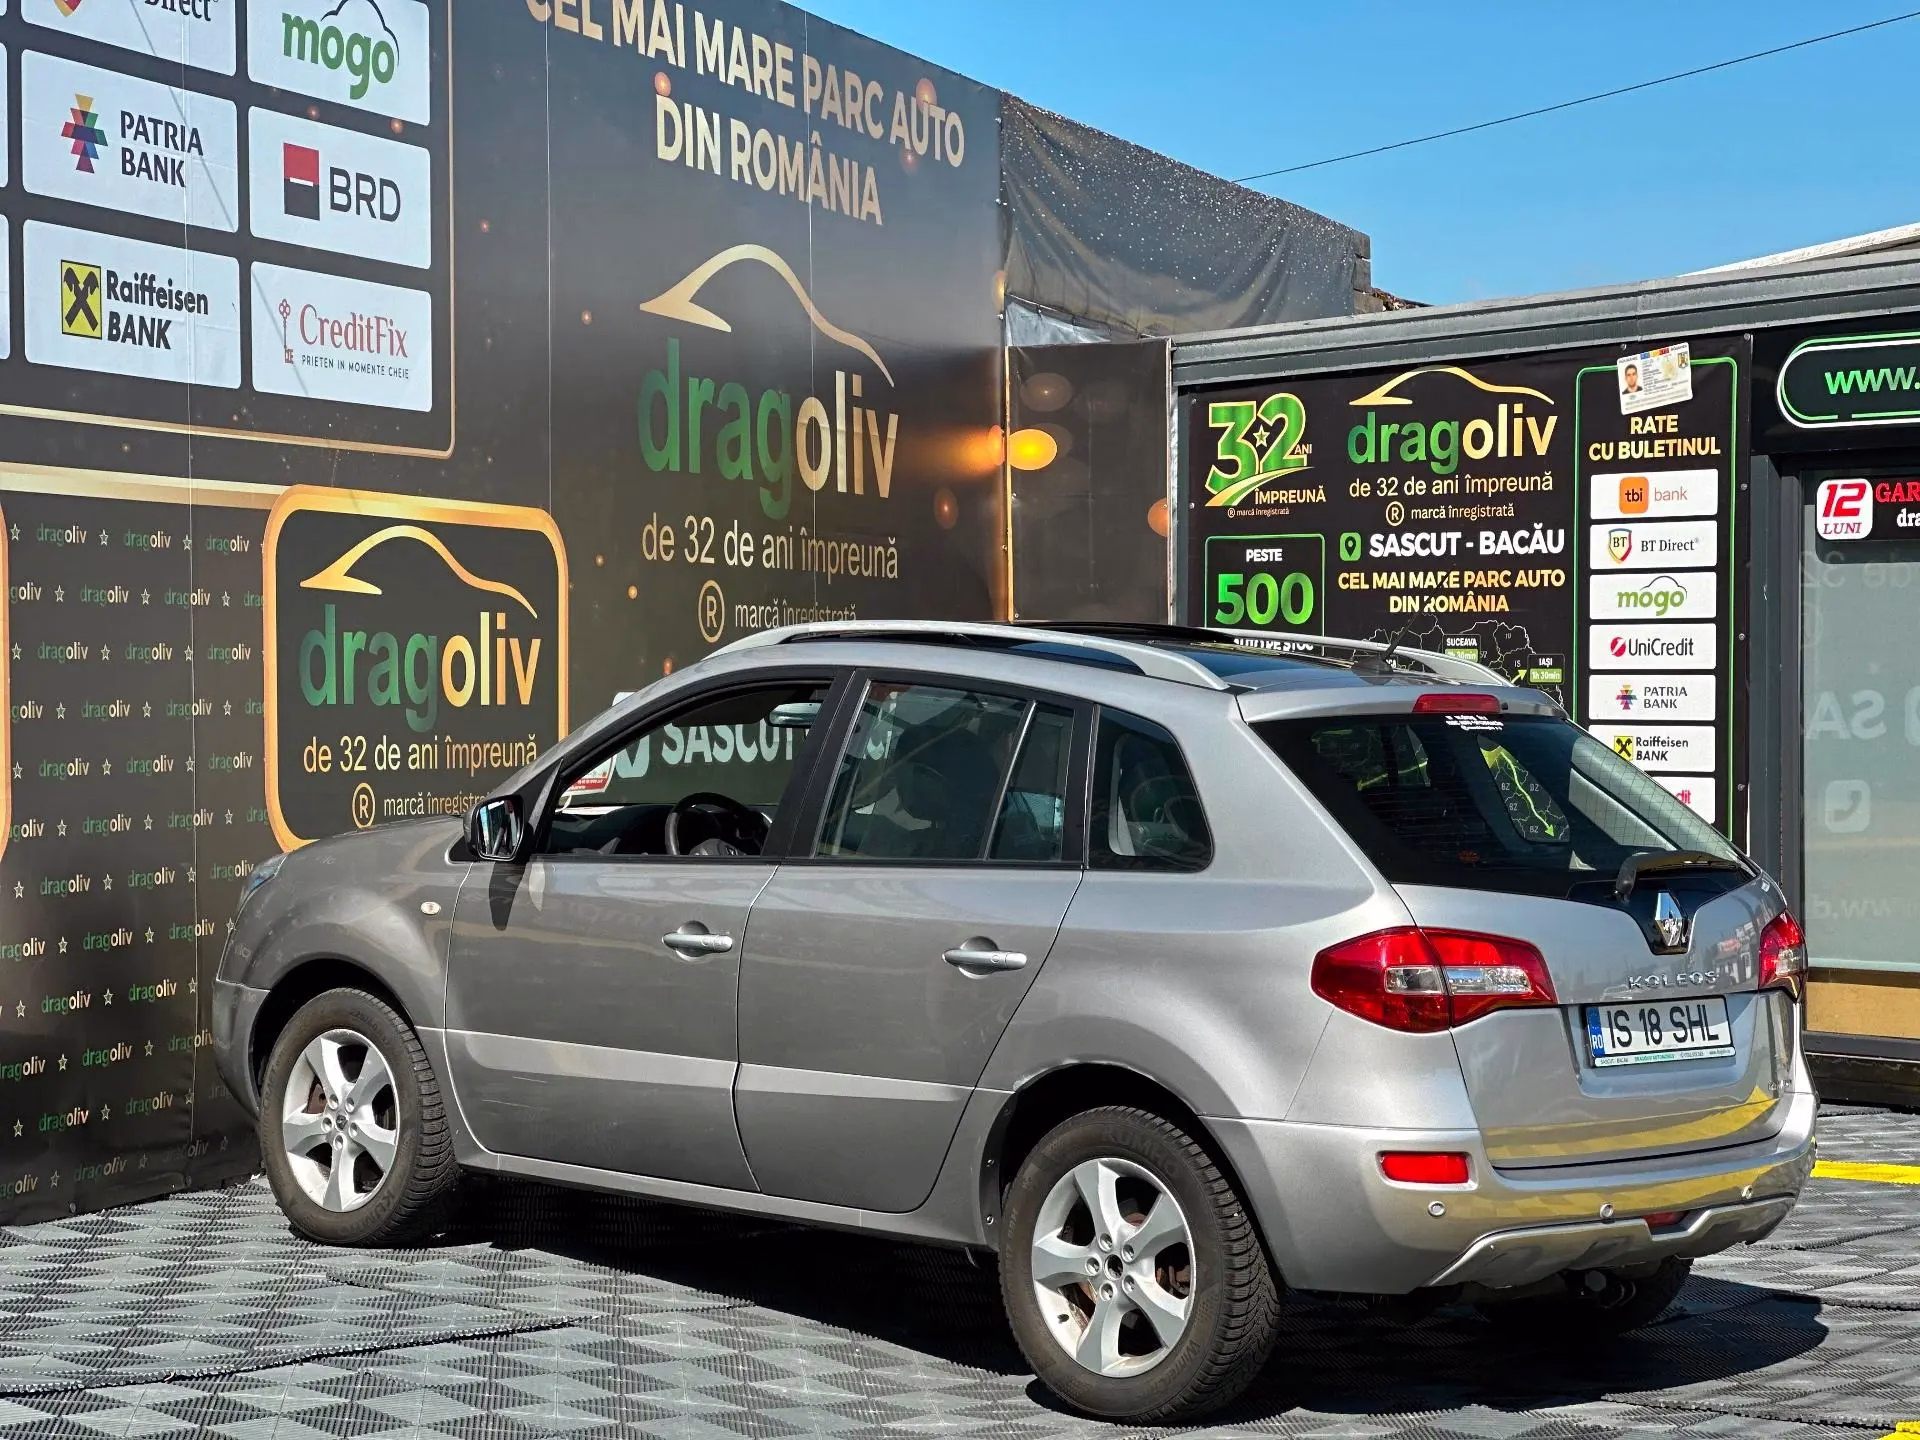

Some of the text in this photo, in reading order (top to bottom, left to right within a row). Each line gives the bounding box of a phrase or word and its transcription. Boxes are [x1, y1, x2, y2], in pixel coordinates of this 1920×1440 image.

[282, 12, 396, 99] mogo
[613, 0, 686, 68] MAI
[695, 10, 795, 108] MARE
[803, 52, 884, 140] PARC
[889, 91, 965, 168] AUTO
[120, 110, 204, 157] PATRIA
[121, 147, 187, 188] BANK
[655, 93, 883, 226] DIN ROMÂNIA
[329, 167, 401, 222] BRD
[106, 270, 209, 315] Raiffeisen
[107, 312, 172, 350] BANK
[299, 303, 408, 358] CreditFix
[302, 355, 409, 380] PRIETEN IN MOMENTE CHEIE
[637, 337, 899, 520] dragoliv
[1630, 414, 1679, 434] RATE
[1205, 392, 1307, 495] 32
[1294, 443, 1313, 455] ANI
[1348, 403, 1558, 475] dragoliv
[1589, 437, 1721, 461] CU BULETINUL
[1255, 485, 1327, 505] ÎMPREUNĂ
[1349, 471, 1554, 497] de 32 de ani împreună
[1624, 486, 1688, 503] tbi bank
[1411, 505, 1446, 520] marcă
[1448, 503, 1515, 521] înregistrată
[1823, 483, 1866, 517] 12
[37, 525, 250, 553] dragoliv dragoliv dragoliv
[1369, 531, 1462, 558] SASCUT
[1479, 523, 1565, 556] BACĂU
[1823, 522, 1863, 535] LUNI
[642, 512, 899, 584] de 32 de ani împreună
[1246, 548, 1283, 563] PESTE
[1641, 540, 1656, 552] BT
[1338, 568, 1566, 590] CEL MAI MARE PARC AUTO
[80, 585, 129, 607] dragoliv
[164, 588, 211, 609] dragoliv
[1214, 572, 1314, 626] 500
[1389, 591, 1510, 613] DIN ROMÂNIA
[1617, 590, 1685, 616] mogo
[735, 598, 780, 629] marcă
[37, 642, 251, 664] dragoliv dragoliv dragoliv
[1446, 637, 1478, 647] SUCEAVA
[1628, 637, 1694, 657] UniCredit
[300, 604, 541, 732] dragoliv
[1643, 686, 1688, 698] PATRIA
[1643, 698, 1678, 709] BANK
[81, 700, 131, 721] dragoliv
[167, 699, 212, 720] dragoliv
[304, 734, 538, 777] de 32 de ani împreună
[1636, 736, 1689, 749] Raiffeisen
[39, 752, 253, 780] dragoliv dragoliv dragoliv
[1636, 750, 1669, 762] BANK
[384, 791, 425, 816] marcă
[82, 814, 132, 836] dragoliv
[167, 809, 213, 831] dragoliv
[40, 875, 91, 897] dragoliv
[127, 867, 175, 889] dragoliv
[83, 928, 133, 951] dragoliv
[169, 919, 215, 942] dragoliv
[1628, 970, 1719, 990] KOLEOS
[41, 979, 177, 1015] dragoliv dragoliv
[1606, 1003, 1719, 1049] IS 18 SHL
[82, 1042, 133, 1067] dragoliv
[1592, 1034, 1604, 1049] RO
[39, 1091, 174, 1132] dragoliv dragoliv
